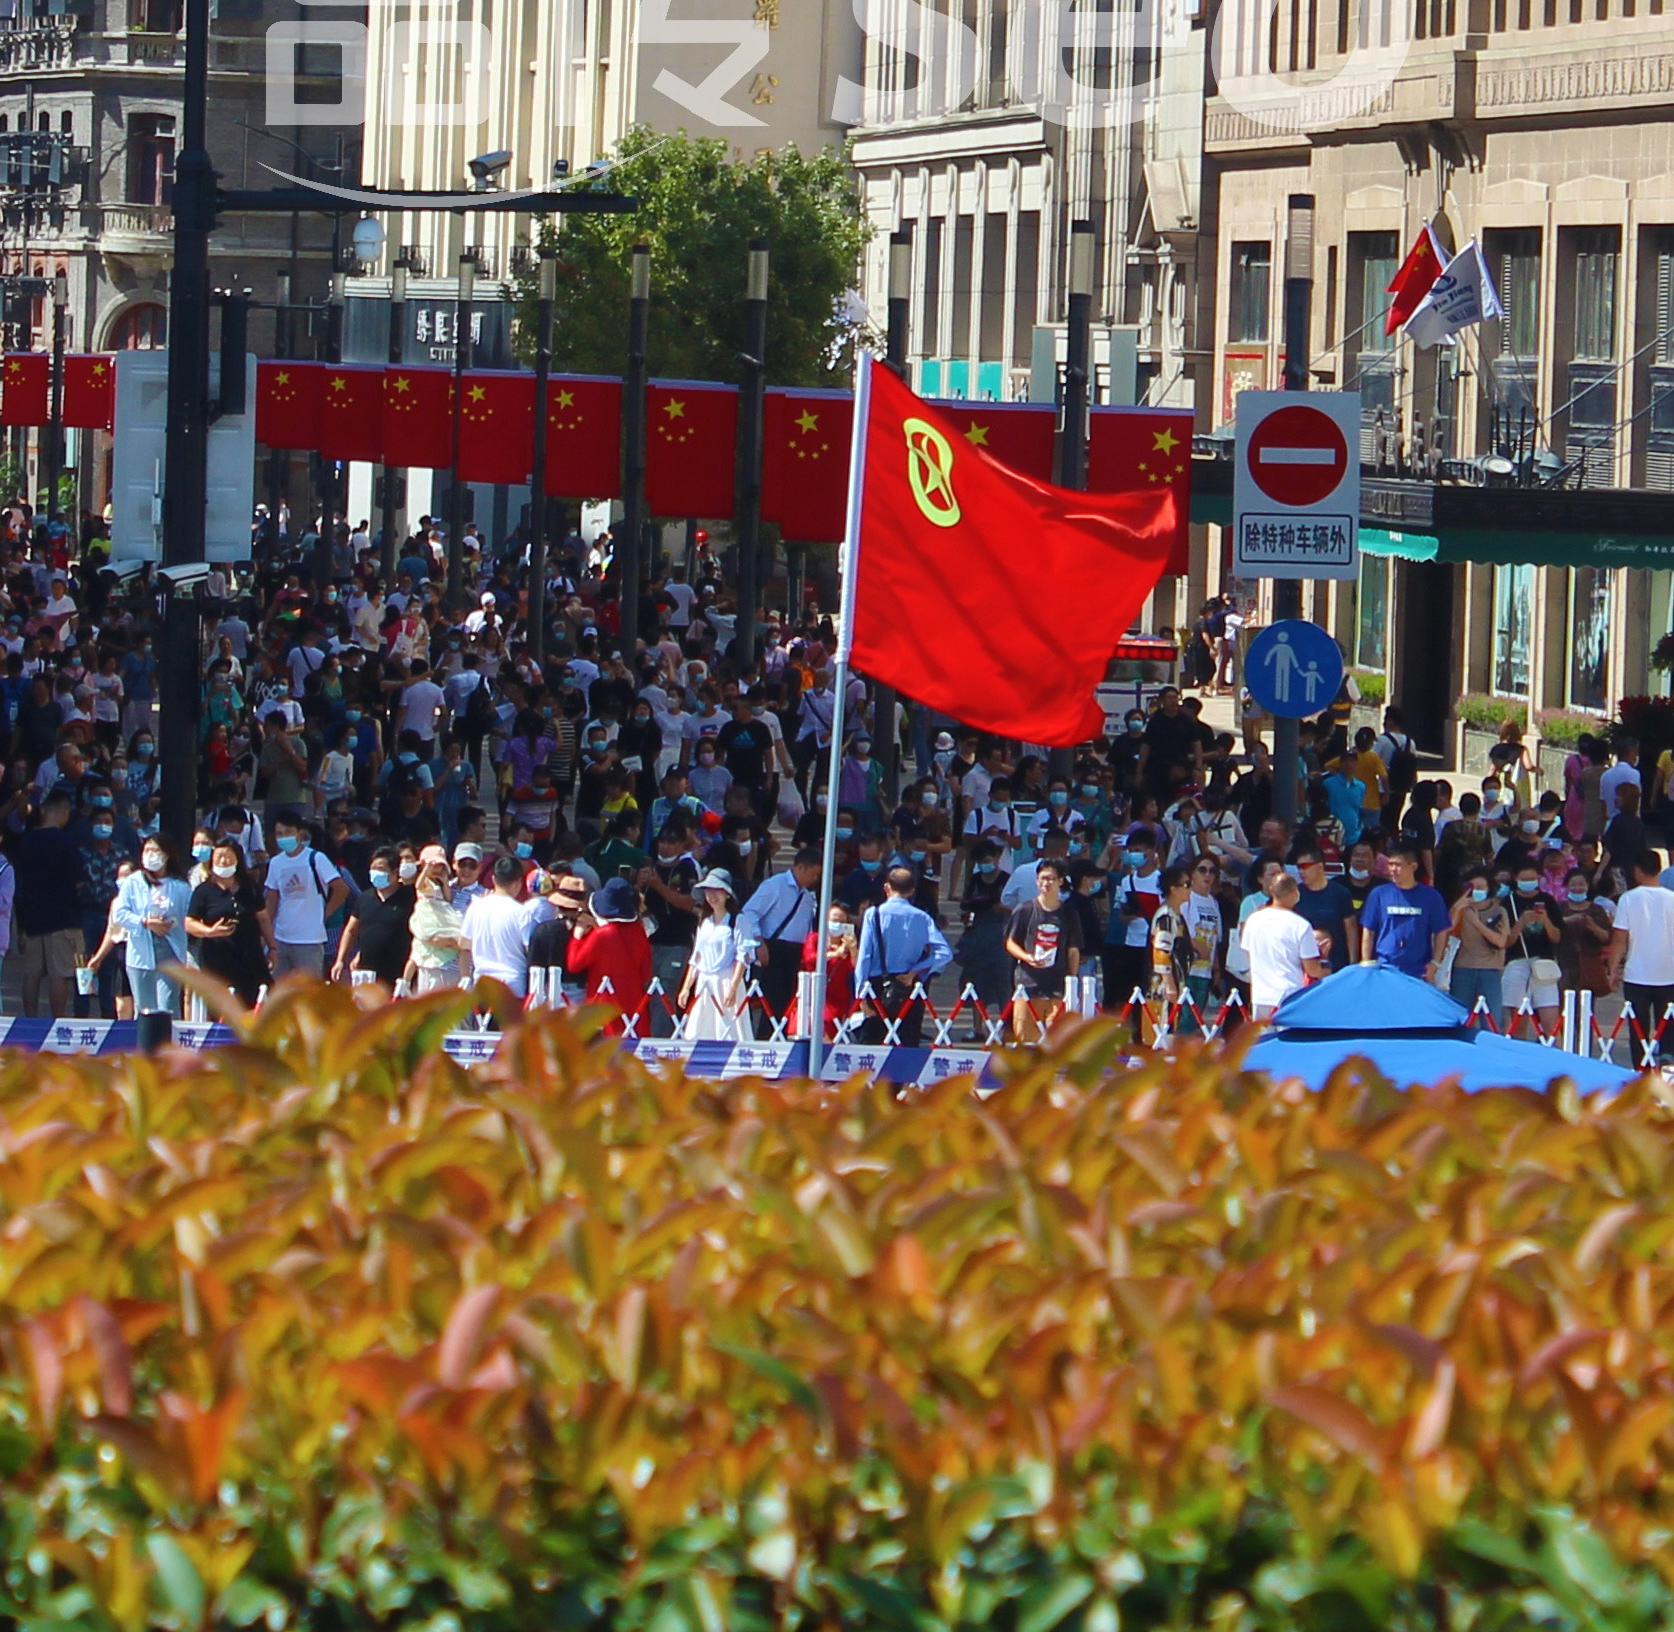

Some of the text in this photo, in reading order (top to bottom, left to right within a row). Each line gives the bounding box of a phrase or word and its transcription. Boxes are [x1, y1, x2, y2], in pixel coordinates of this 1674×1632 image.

[1245, 523, 1346, 554] 除特种车辆外
[56, 1026, 97, 1047] 警戒
[738, 1048, 778, 1068] 警戒
[834, 1052, 875, 1072] 警戒
[932, 1057, 974, 1076] 警戒
